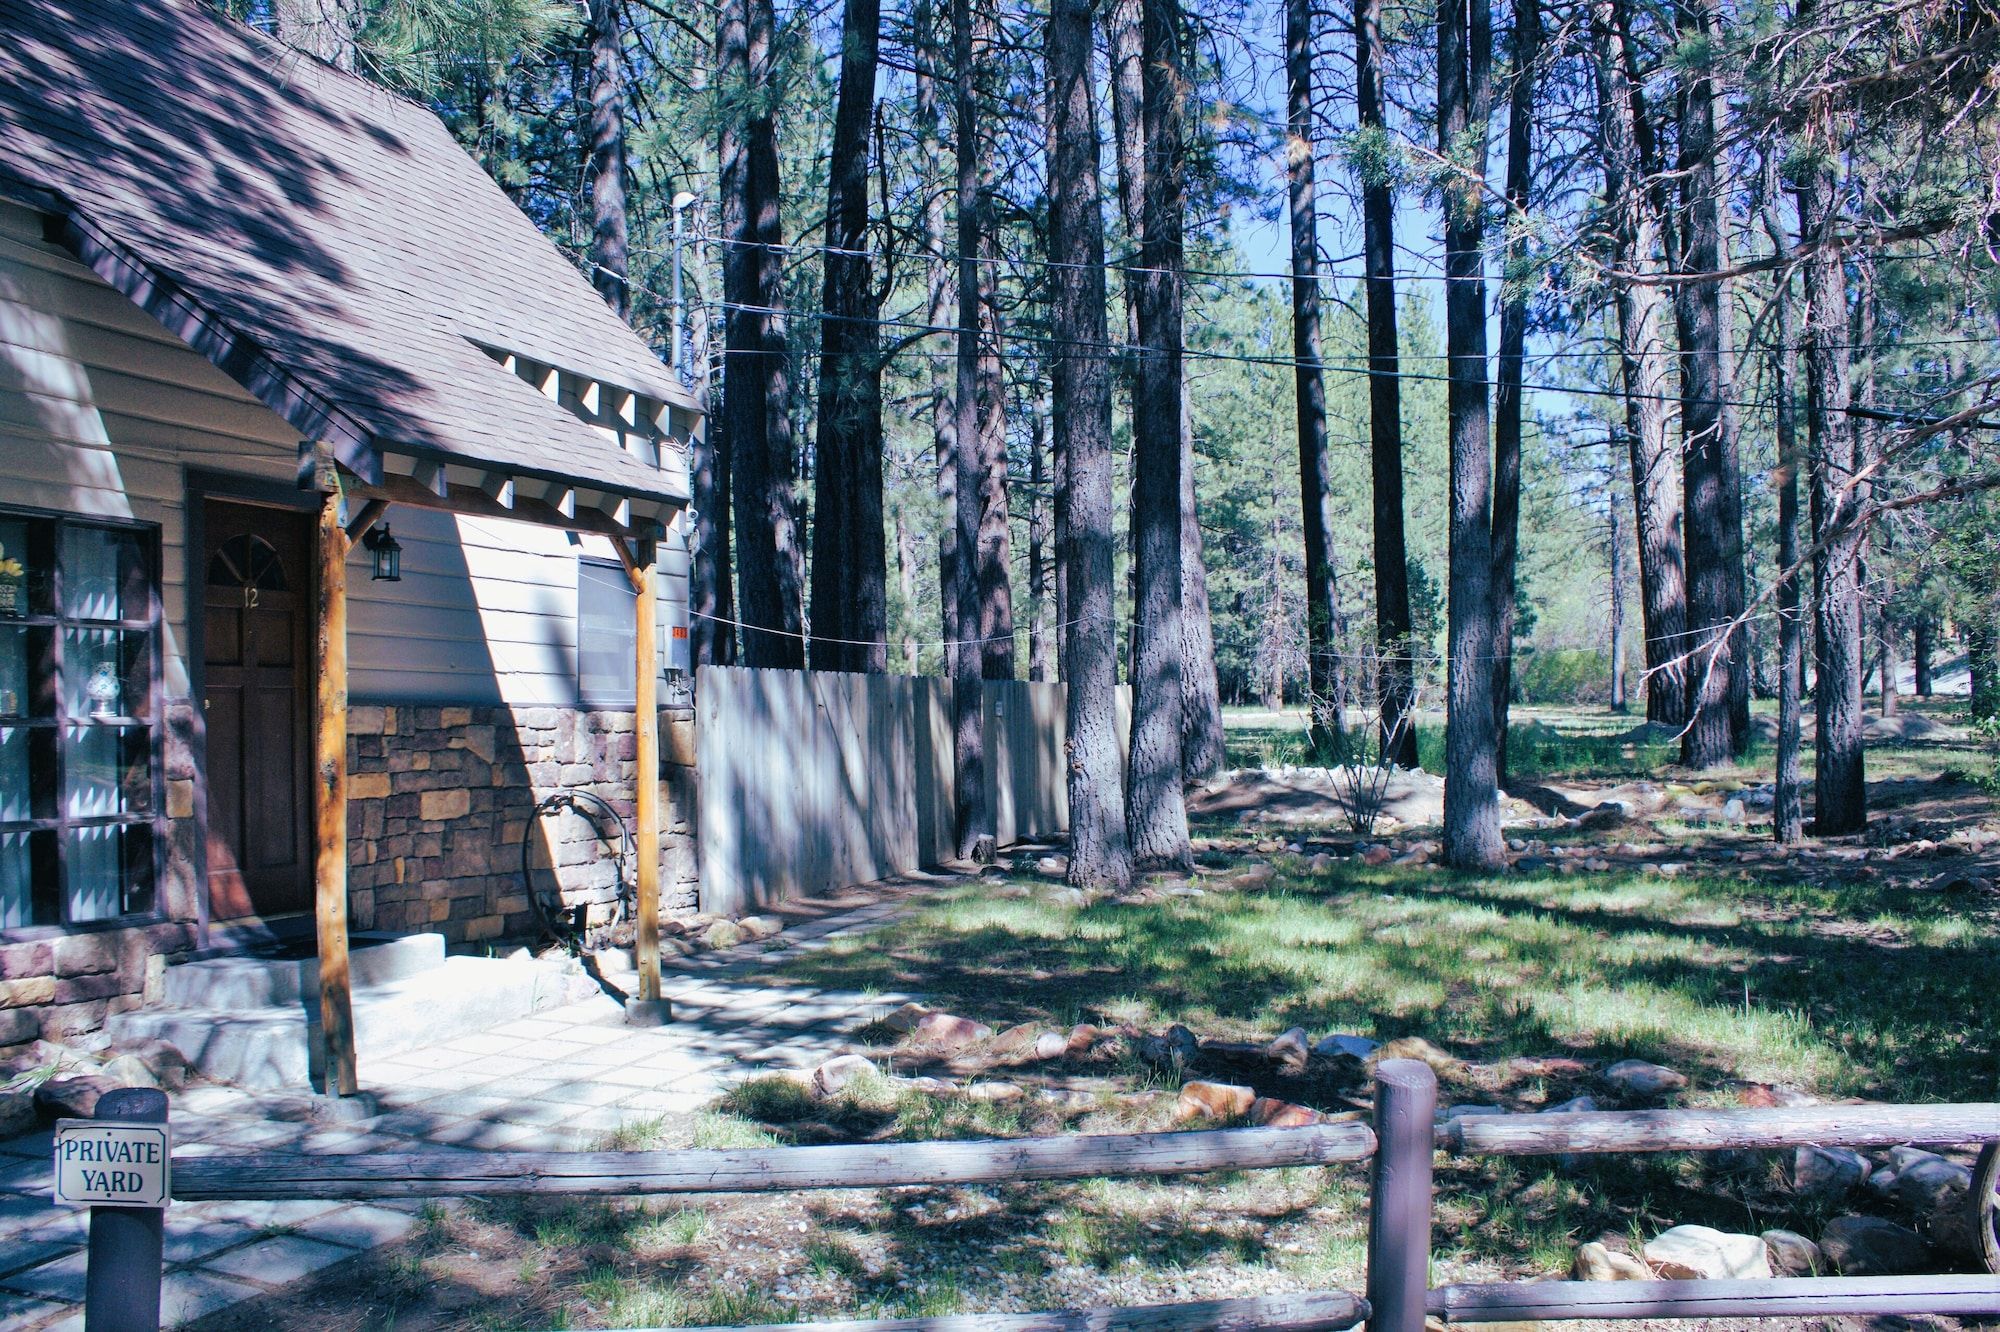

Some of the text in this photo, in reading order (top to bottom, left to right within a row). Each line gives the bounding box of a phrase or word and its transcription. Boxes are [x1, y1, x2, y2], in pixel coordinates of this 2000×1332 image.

[244, 587, 259, 608] 12
[65, 1139, 160, 1164] PRIVATE
[81, 1170, 143, 1193] YARD
